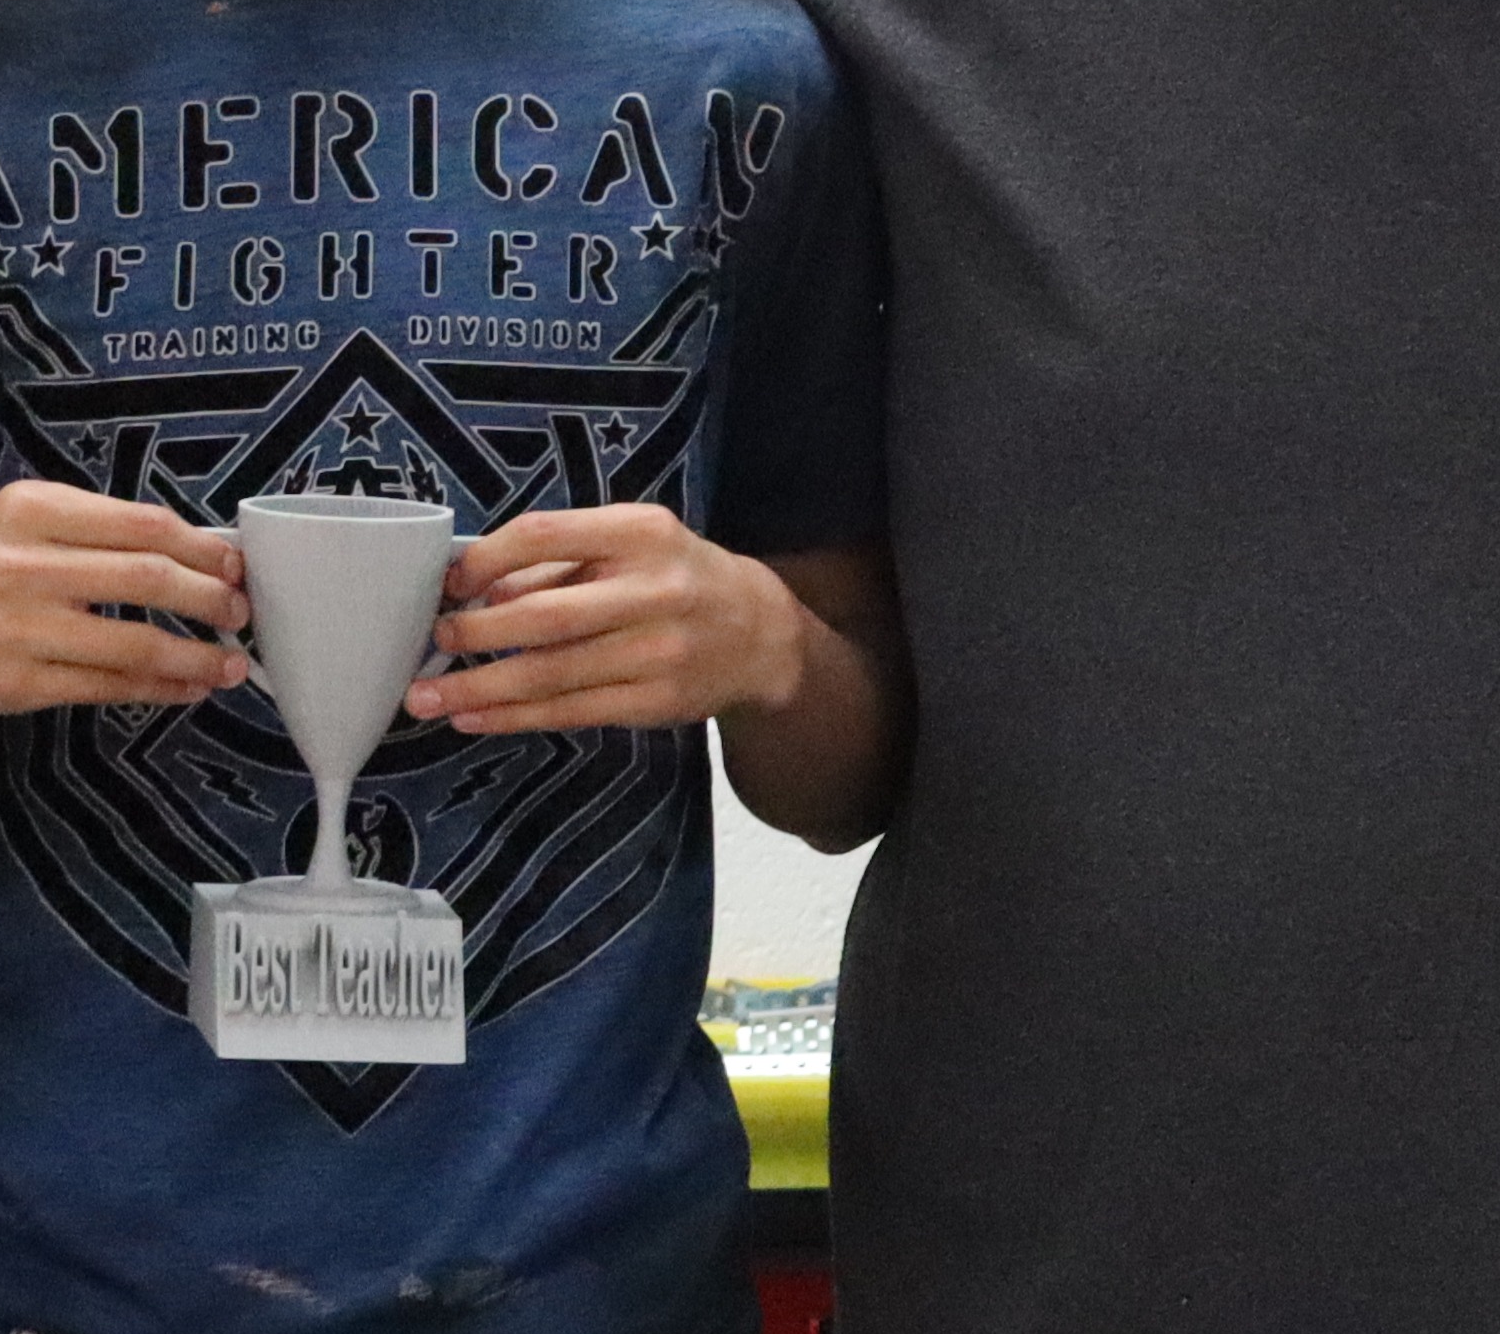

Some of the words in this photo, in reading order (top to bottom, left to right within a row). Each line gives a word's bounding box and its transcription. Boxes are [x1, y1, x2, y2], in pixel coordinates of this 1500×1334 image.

[93, 227, 620, 318] FIGHTER
[103, 319, 321, 364] TRAINING
[406, 315, 604, 353] DIVISION
[225, 911, 304, 1017] Best
[312, 909, 460, 1020] Teacher
